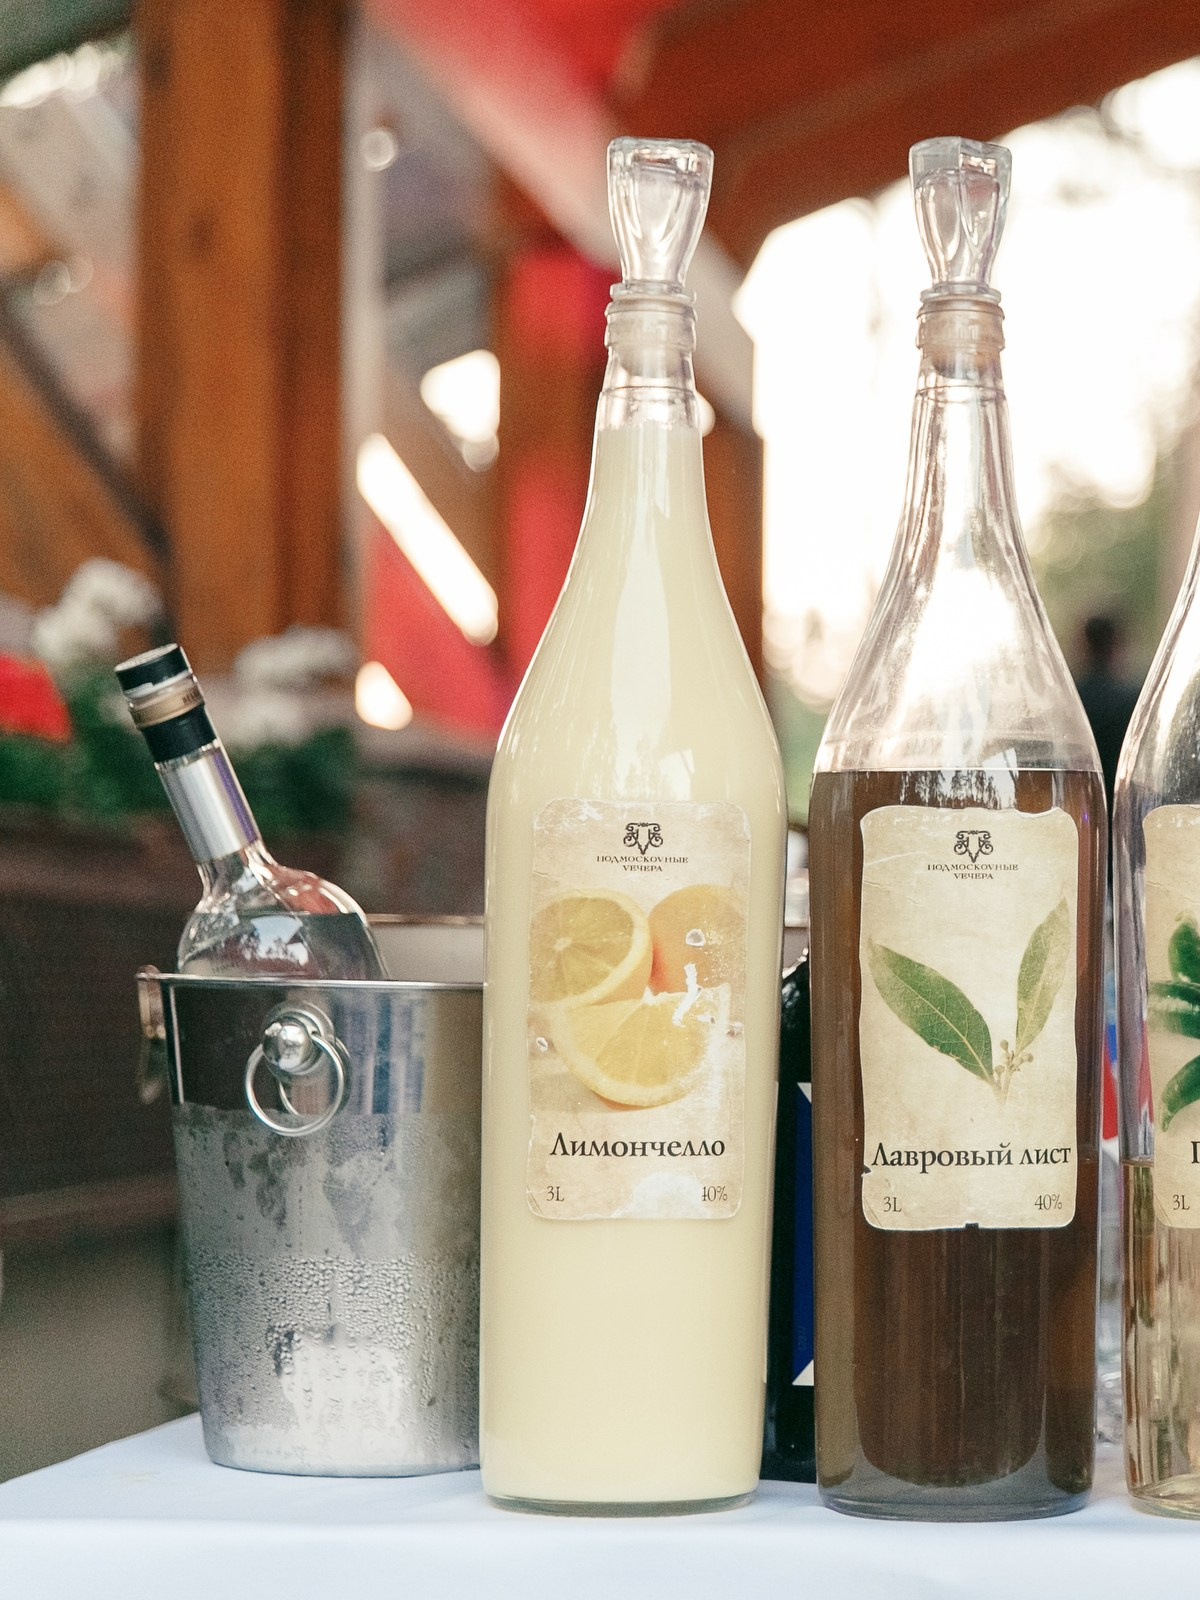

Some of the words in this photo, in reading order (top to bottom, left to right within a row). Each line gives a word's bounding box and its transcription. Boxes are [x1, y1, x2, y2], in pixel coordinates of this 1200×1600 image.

[549, 1132, 726, 1156] Лимончелло
[871, 1142, 1013, 1173] Лавровый
[1019, 1147, 1071, 1165] лист
[546, 1186, 565, 1201] 3L
[883, 1197, 903, 1212] 3L
[1034, 1194, 1063, 1211] 40%
[1172, 1194, 1190, 1211] 3L
